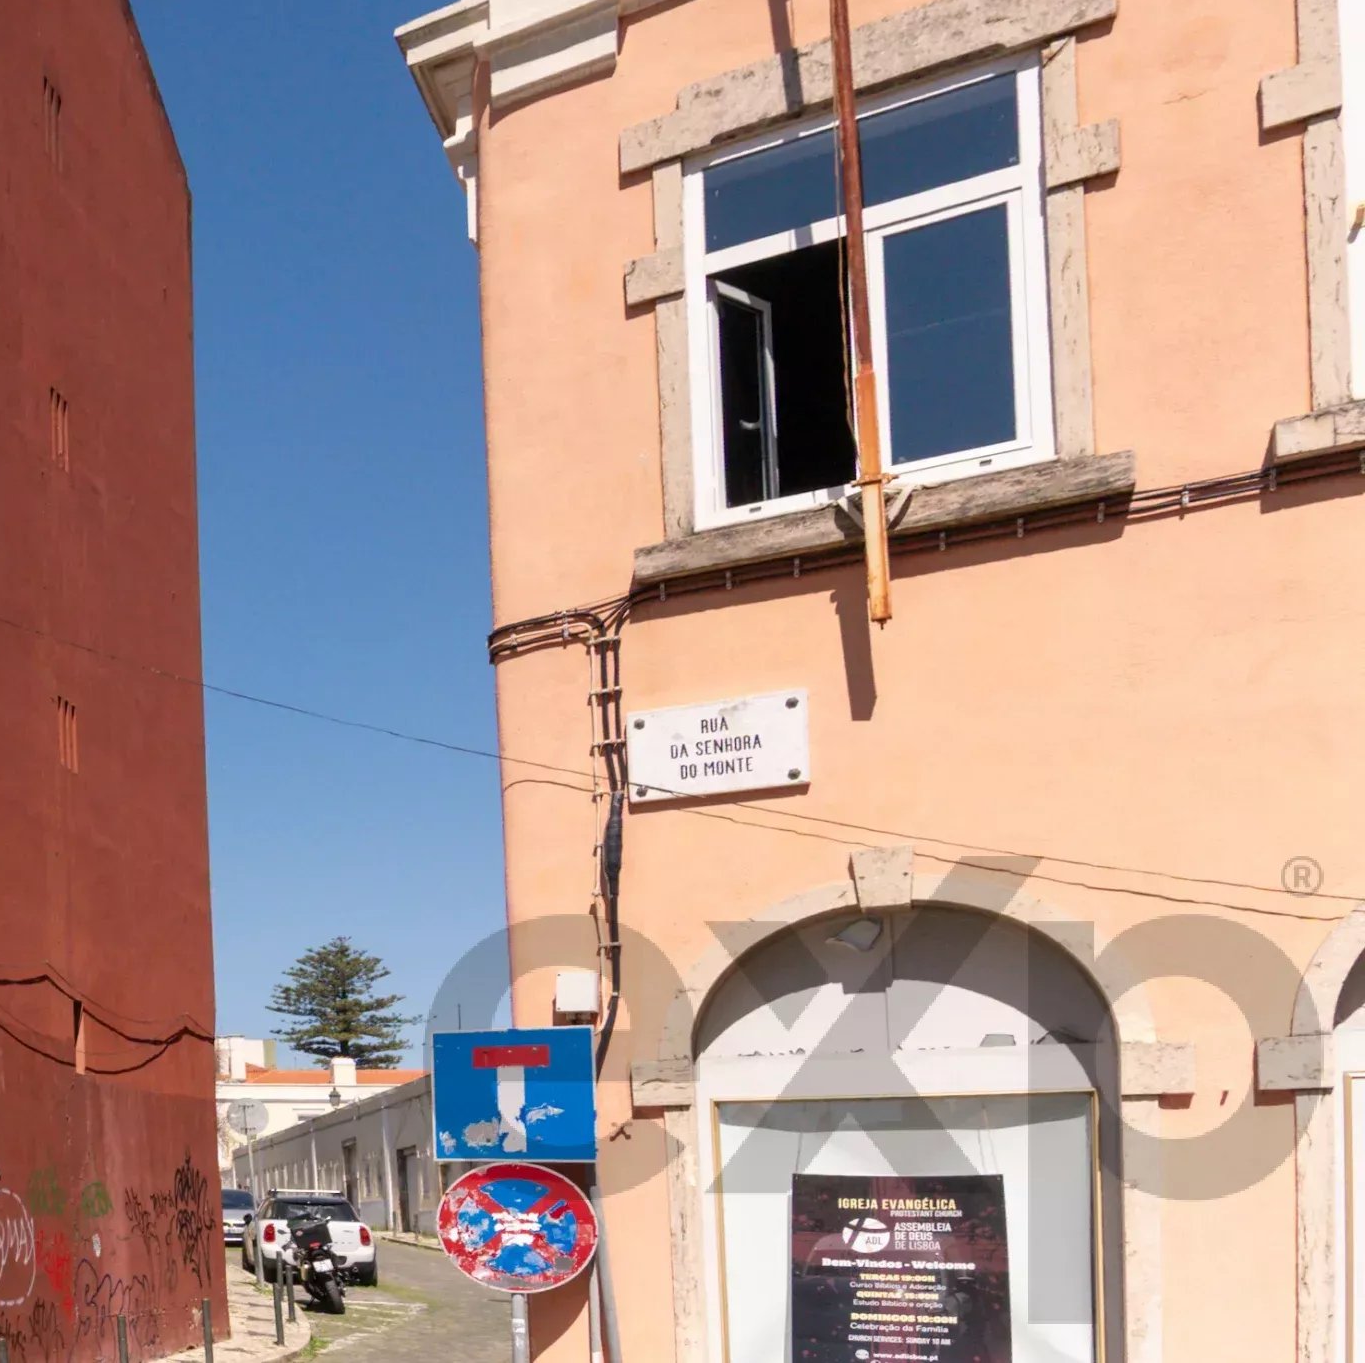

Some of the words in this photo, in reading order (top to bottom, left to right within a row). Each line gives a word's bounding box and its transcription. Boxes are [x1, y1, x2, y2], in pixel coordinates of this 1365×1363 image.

[701, 716, 729, 734] RUA
[670, 744, 689, 759] DA
[695, 734, 762, 756] SENHORA
[680, 764, 697, 780] DO
[703, 756, 754, 777] MONTE
[837, 1198, 878, 1210] IGREJA
[882, 1196, 956, 1210] EVANGÉLICA
[890, 1210, 933, 1218] PROTESTANT
[934, 1210, 962, 1218] CHURCH
[894, 1222, 952, 1232] ASSEMBLEIA
[865, 1236, 883, 1246] ADL
[894, 1232, 906, 1241] DE
[908, 1232, 933, 1241] DEUS
[895, 1241, 907, 1250] DE
[909, 1241, 941, 1251] LISBOA
[821, 1257, 903, 1269] Bem-Vindos
[912, 1260, 976, 1270] Welcome
[909, 1283, 947, 1293] Adoração
[856, 1290, 902, 1299] QUINTAS
[852, 1298, 880, 1307] Estudo
[915, 1301, 943, 1310] oração
[850, 1312, 916, 1323] DOMINGOS
[916, 1315, 958, 1324] 10:00H
[849, 1322, 901, 1333] Celebração
[902, 1324, 914, 1332] da
[915, 1324, 949, 1333] Família
[848, 1334, 872, 1342] CHURCH
[905, 1336, 931, 1345] SUNDAY
[940, 1337, 951, 1346] AM
